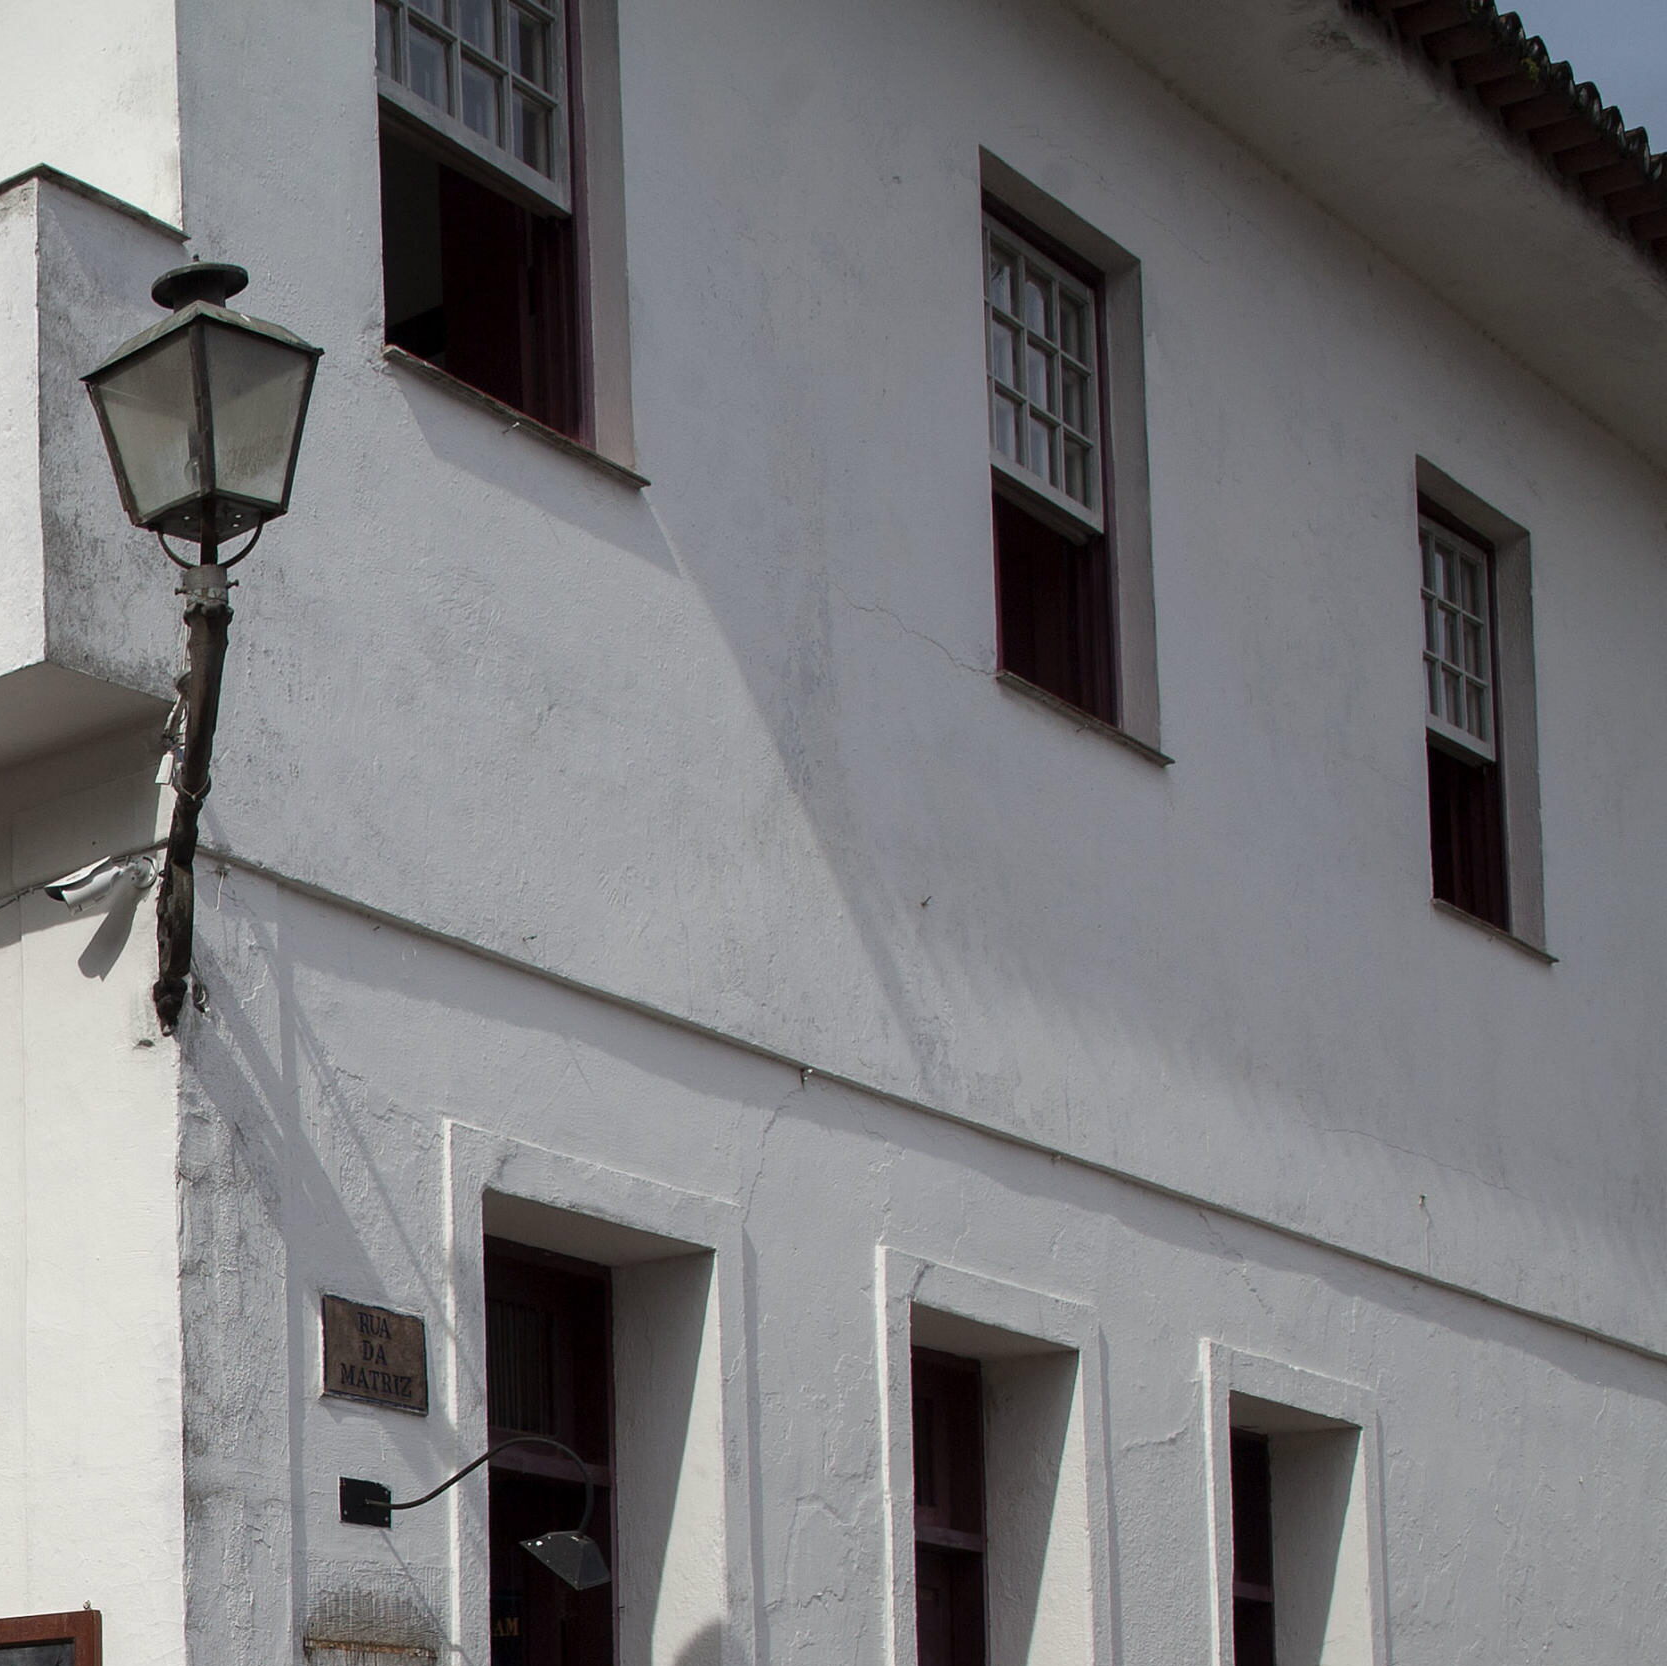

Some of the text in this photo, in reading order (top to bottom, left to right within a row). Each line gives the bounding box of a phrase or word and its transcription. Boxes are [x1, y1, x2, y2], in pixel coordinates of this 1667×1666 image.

[358, 1311, 392, 1340] RUA
[362, 1340, 387, 1366] DA
[340, 1362, 412, 1398] MATRIZ
